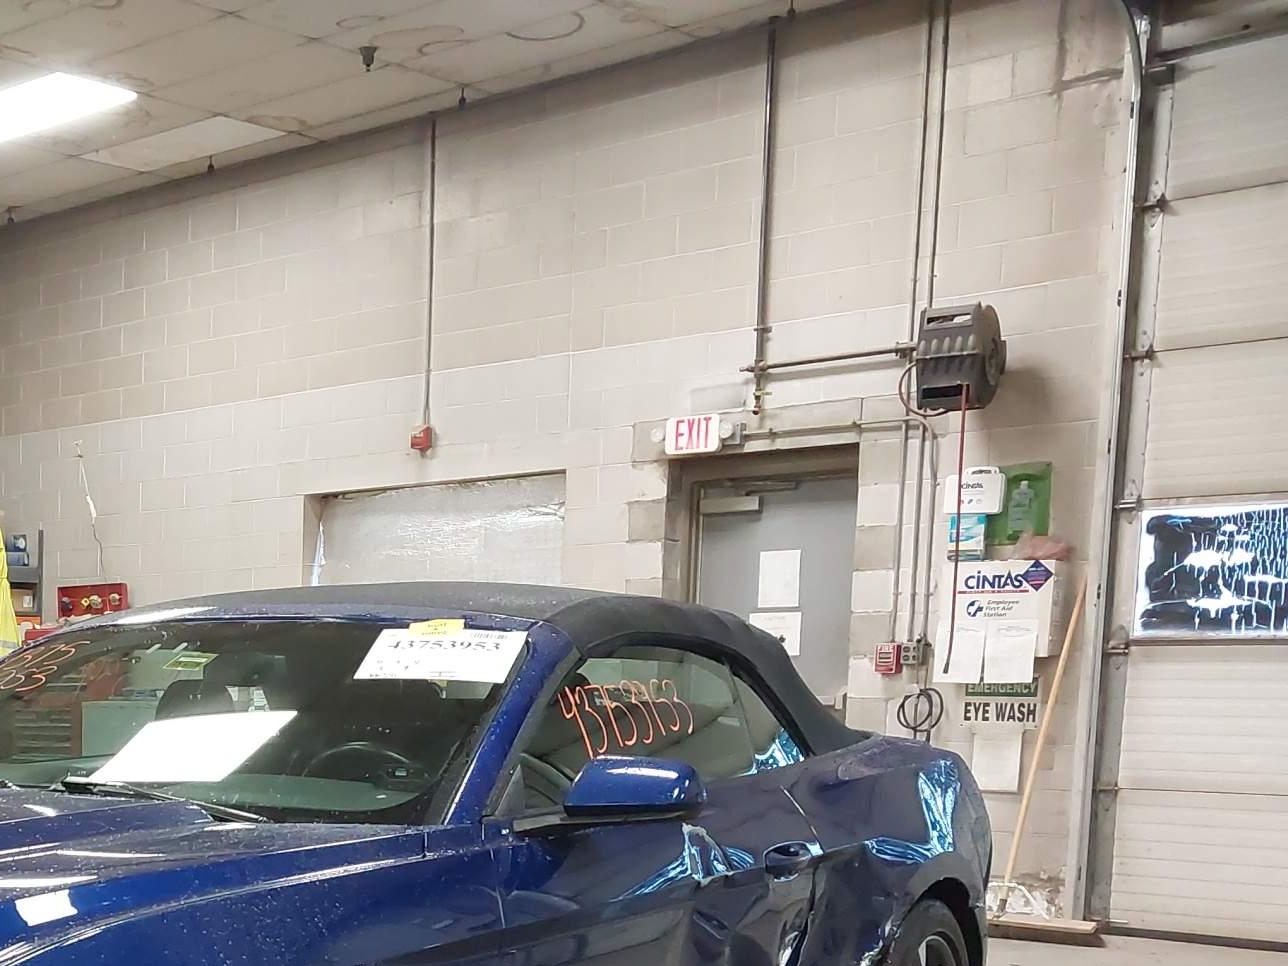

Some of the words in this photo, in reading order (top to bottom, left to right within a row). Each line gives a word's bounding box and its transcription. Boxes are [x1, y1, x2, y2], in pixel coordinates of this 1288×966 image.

[674, 417, 713, 451] EXIT
[388, 640, 501, 651] 43753953
[967, 683, 1038, 693] EMERGENCY
[964, 702, 990, 721] EYE
[995, 702, 1037, 722] WASH
